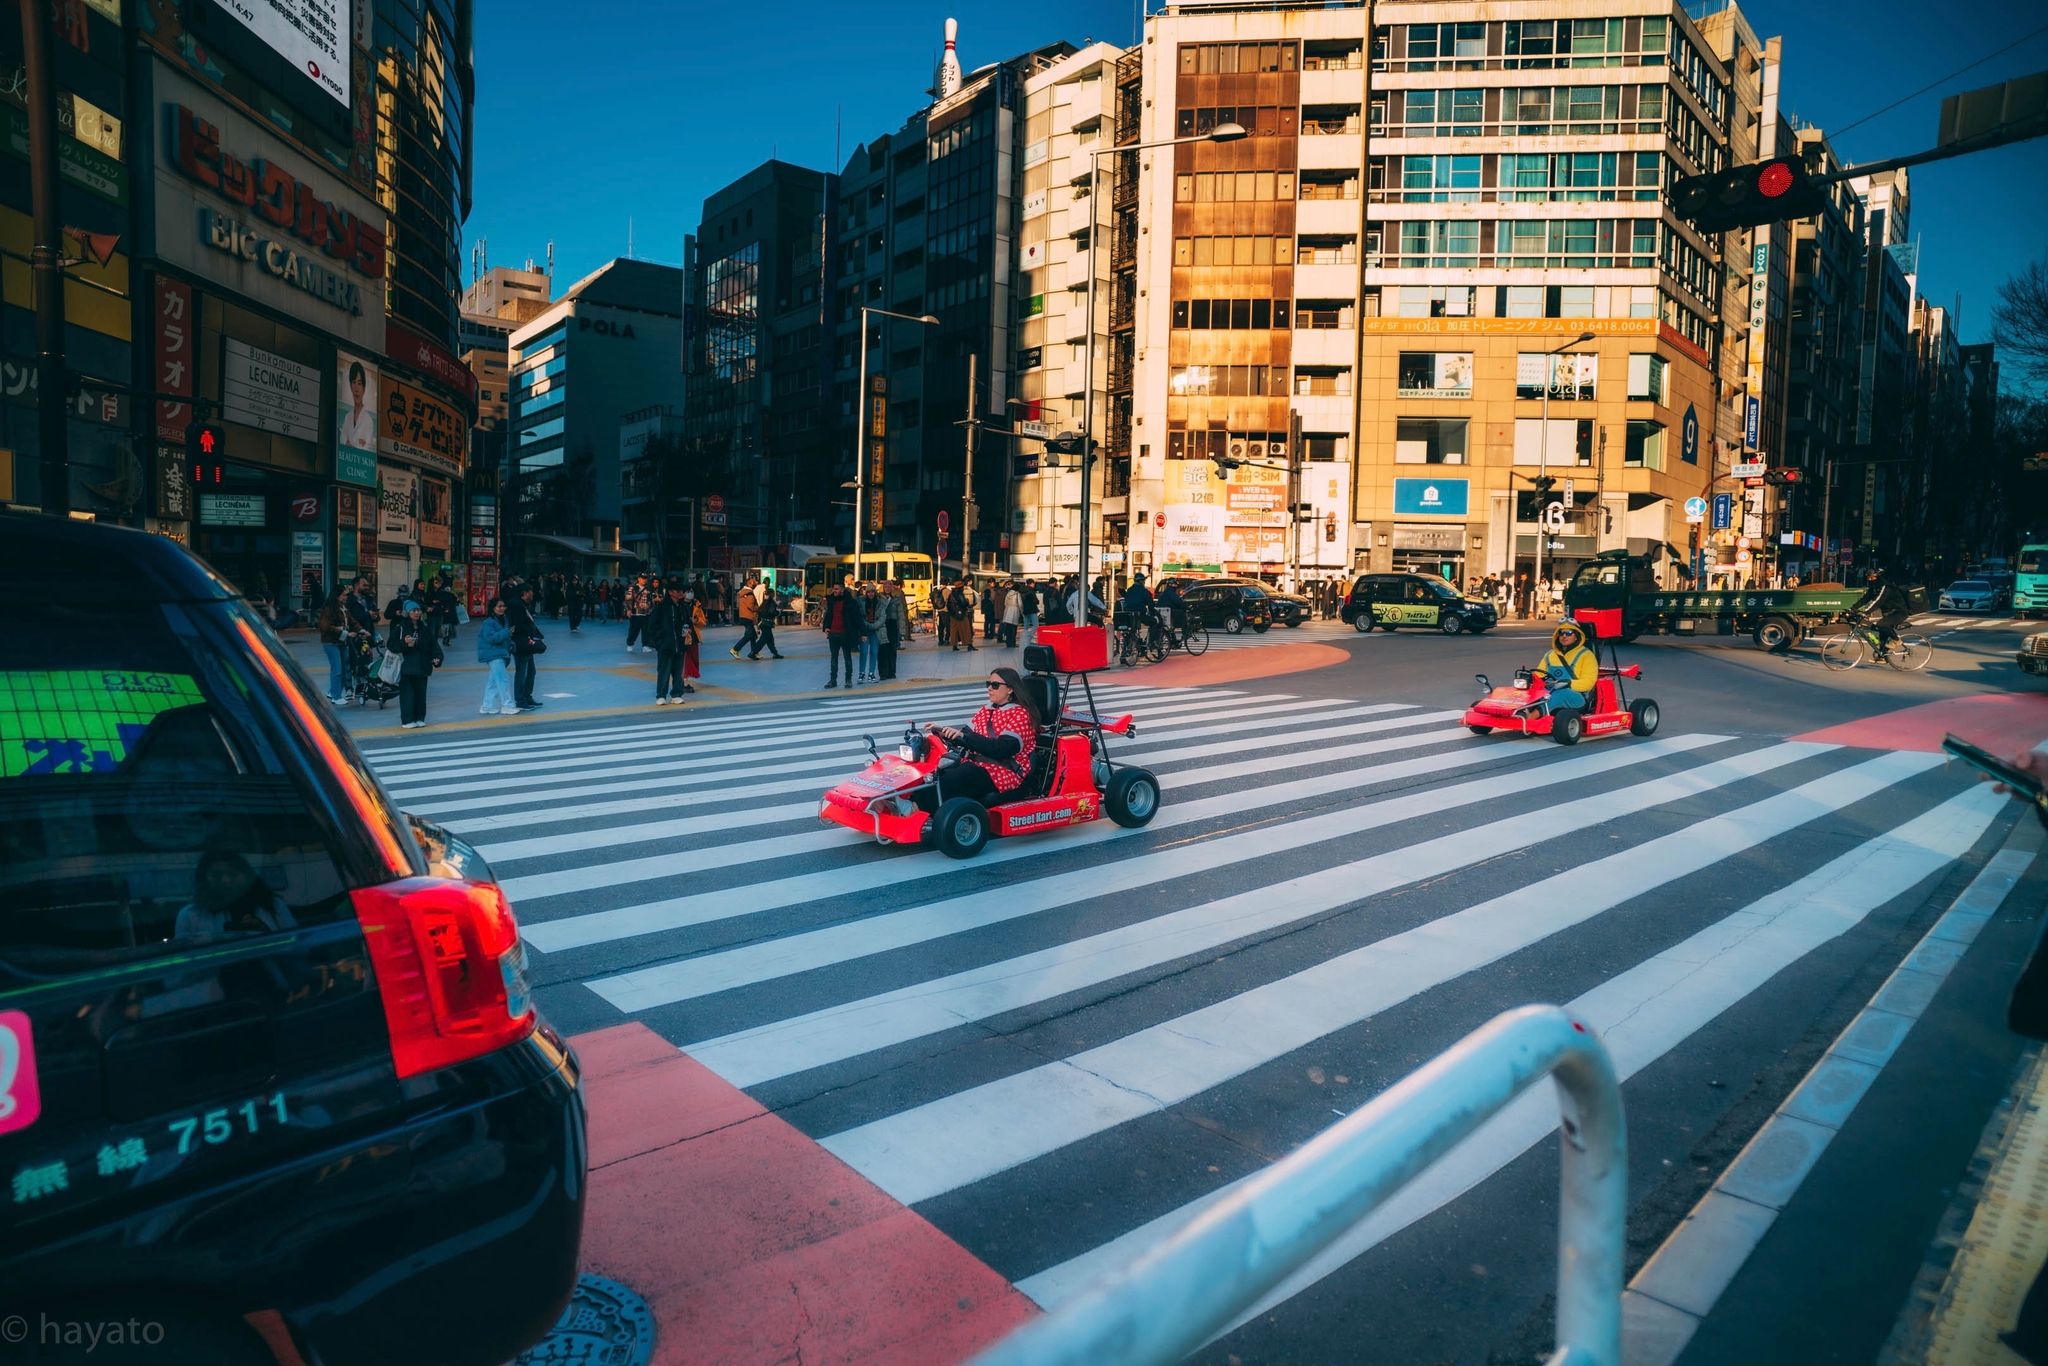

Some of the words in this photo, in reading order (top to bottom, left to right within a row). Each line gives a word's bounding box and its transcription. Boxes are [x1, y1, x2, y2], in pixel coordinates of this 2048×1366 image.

[321, 73, 343, 95] KYODO
[164, 103, 386, 280] ビックカメラ
[1024, 197, 1047, 211] LUXY
[202, 209, 259, 263] BIC
[260, 241, 364, 317] CAMERA
[1756, 247, 1765, 273] NOVA
[579, 316, 636, 340] POLA
[1542, 320, 1565, 331] ジム
[1570, 321, 1651, 332] 03.6418.0064
[162, 290, 187, 420] カラオケ
[250, 348, 302, 375] Bunkamura
[339, 451, 360, 465] BEAUTY
[346, 467, 368, 479] CLINIC
[1183, 474, 1209, 484] BIG
[382, 490, 411, 506] GHOST
[381, 501, 412, 516] WORLD
[1179, 525, 1208, 533] WINNER
[168, 1091, 288, 1156] 7511
